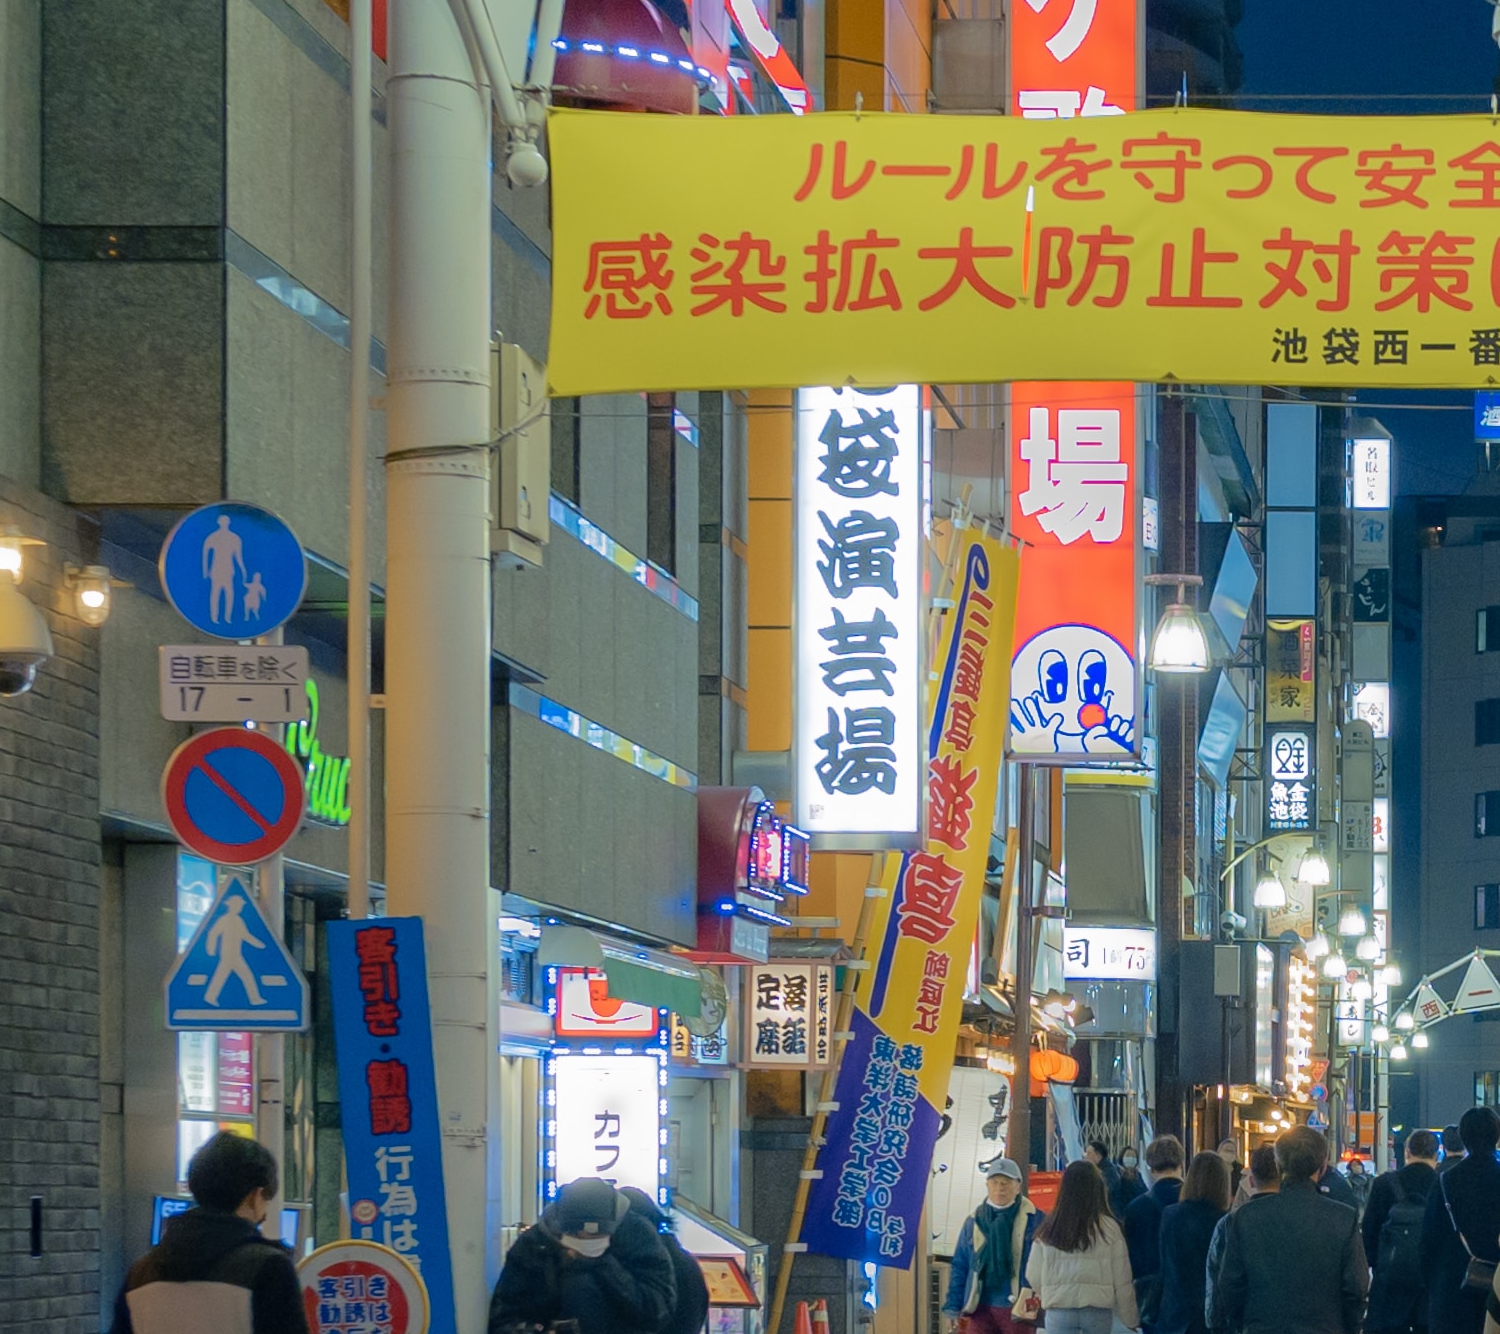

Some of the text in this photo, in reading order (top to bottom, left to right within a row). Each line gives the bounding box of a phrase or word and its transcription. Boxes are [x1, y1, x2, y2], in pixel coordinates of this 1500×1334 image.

[1019, 407, 1128, 545] 場
[815, 385, 899, 795] 袋演芸場
[171, 655, 299, 681] 自転車を除く
[180, 687, 205, 712] 17
[1269, 802, 1309, 820] 池袋
[594, 1109, 620, 1184] カフ
[319, 1276, 387, 1298] 客引き
[320, 1302, 390, 1324] 勧誘は
